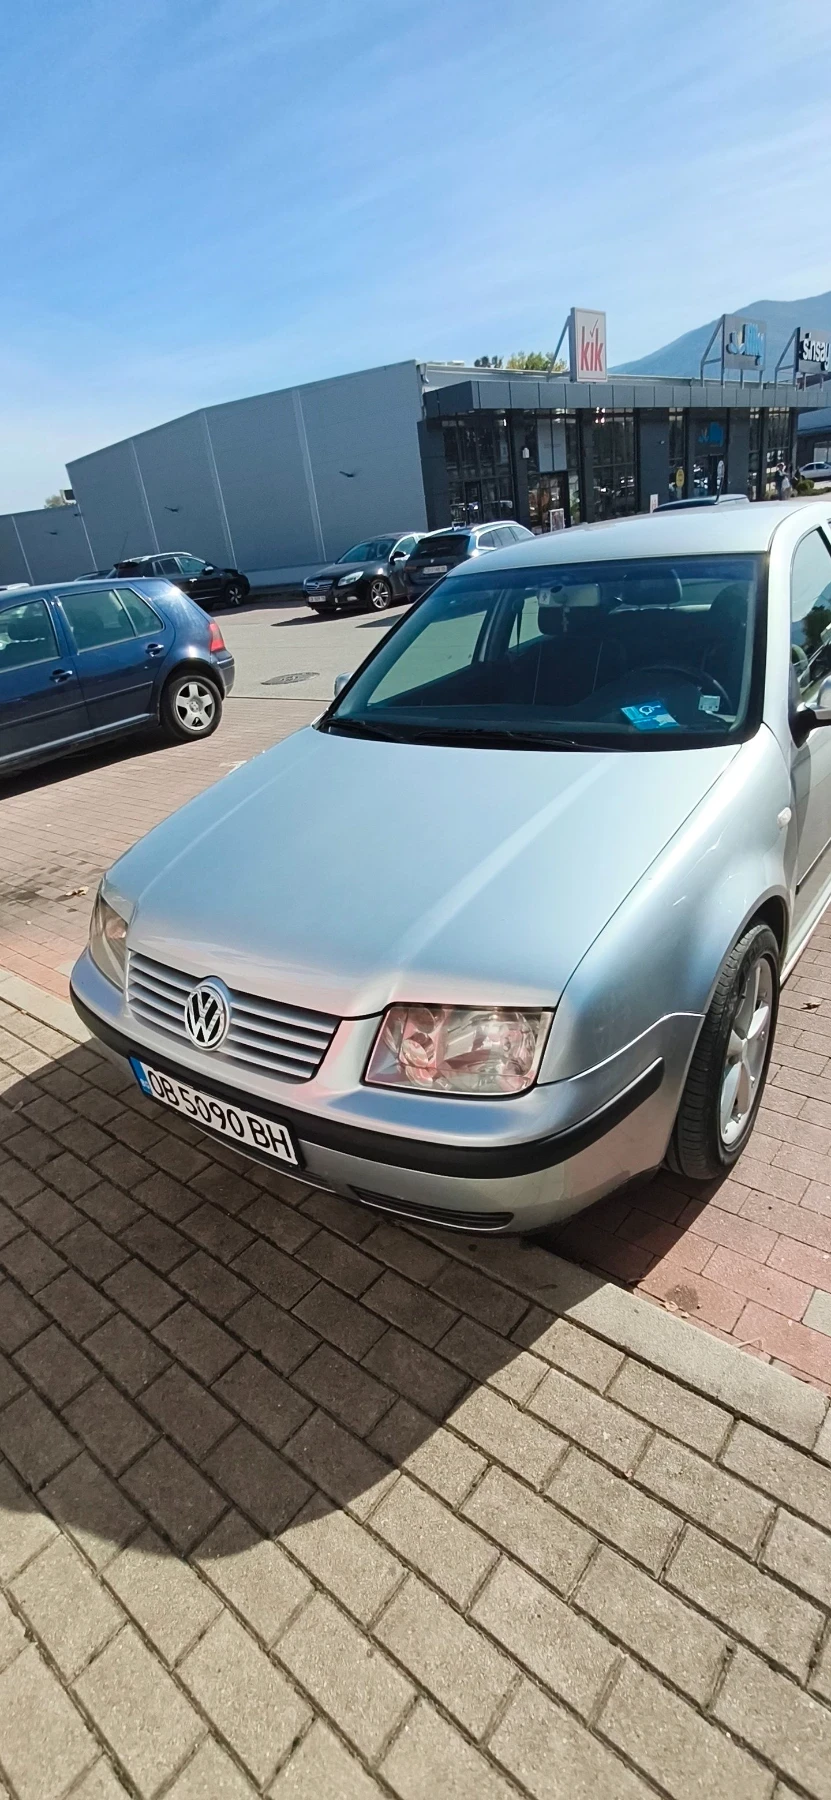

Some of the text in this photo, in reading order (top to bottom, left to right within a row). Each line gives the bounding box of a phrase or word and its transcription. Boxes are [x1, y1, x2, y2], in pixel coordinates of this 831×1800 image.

[148, 1070, 293, 1159] OB 5090 BH
